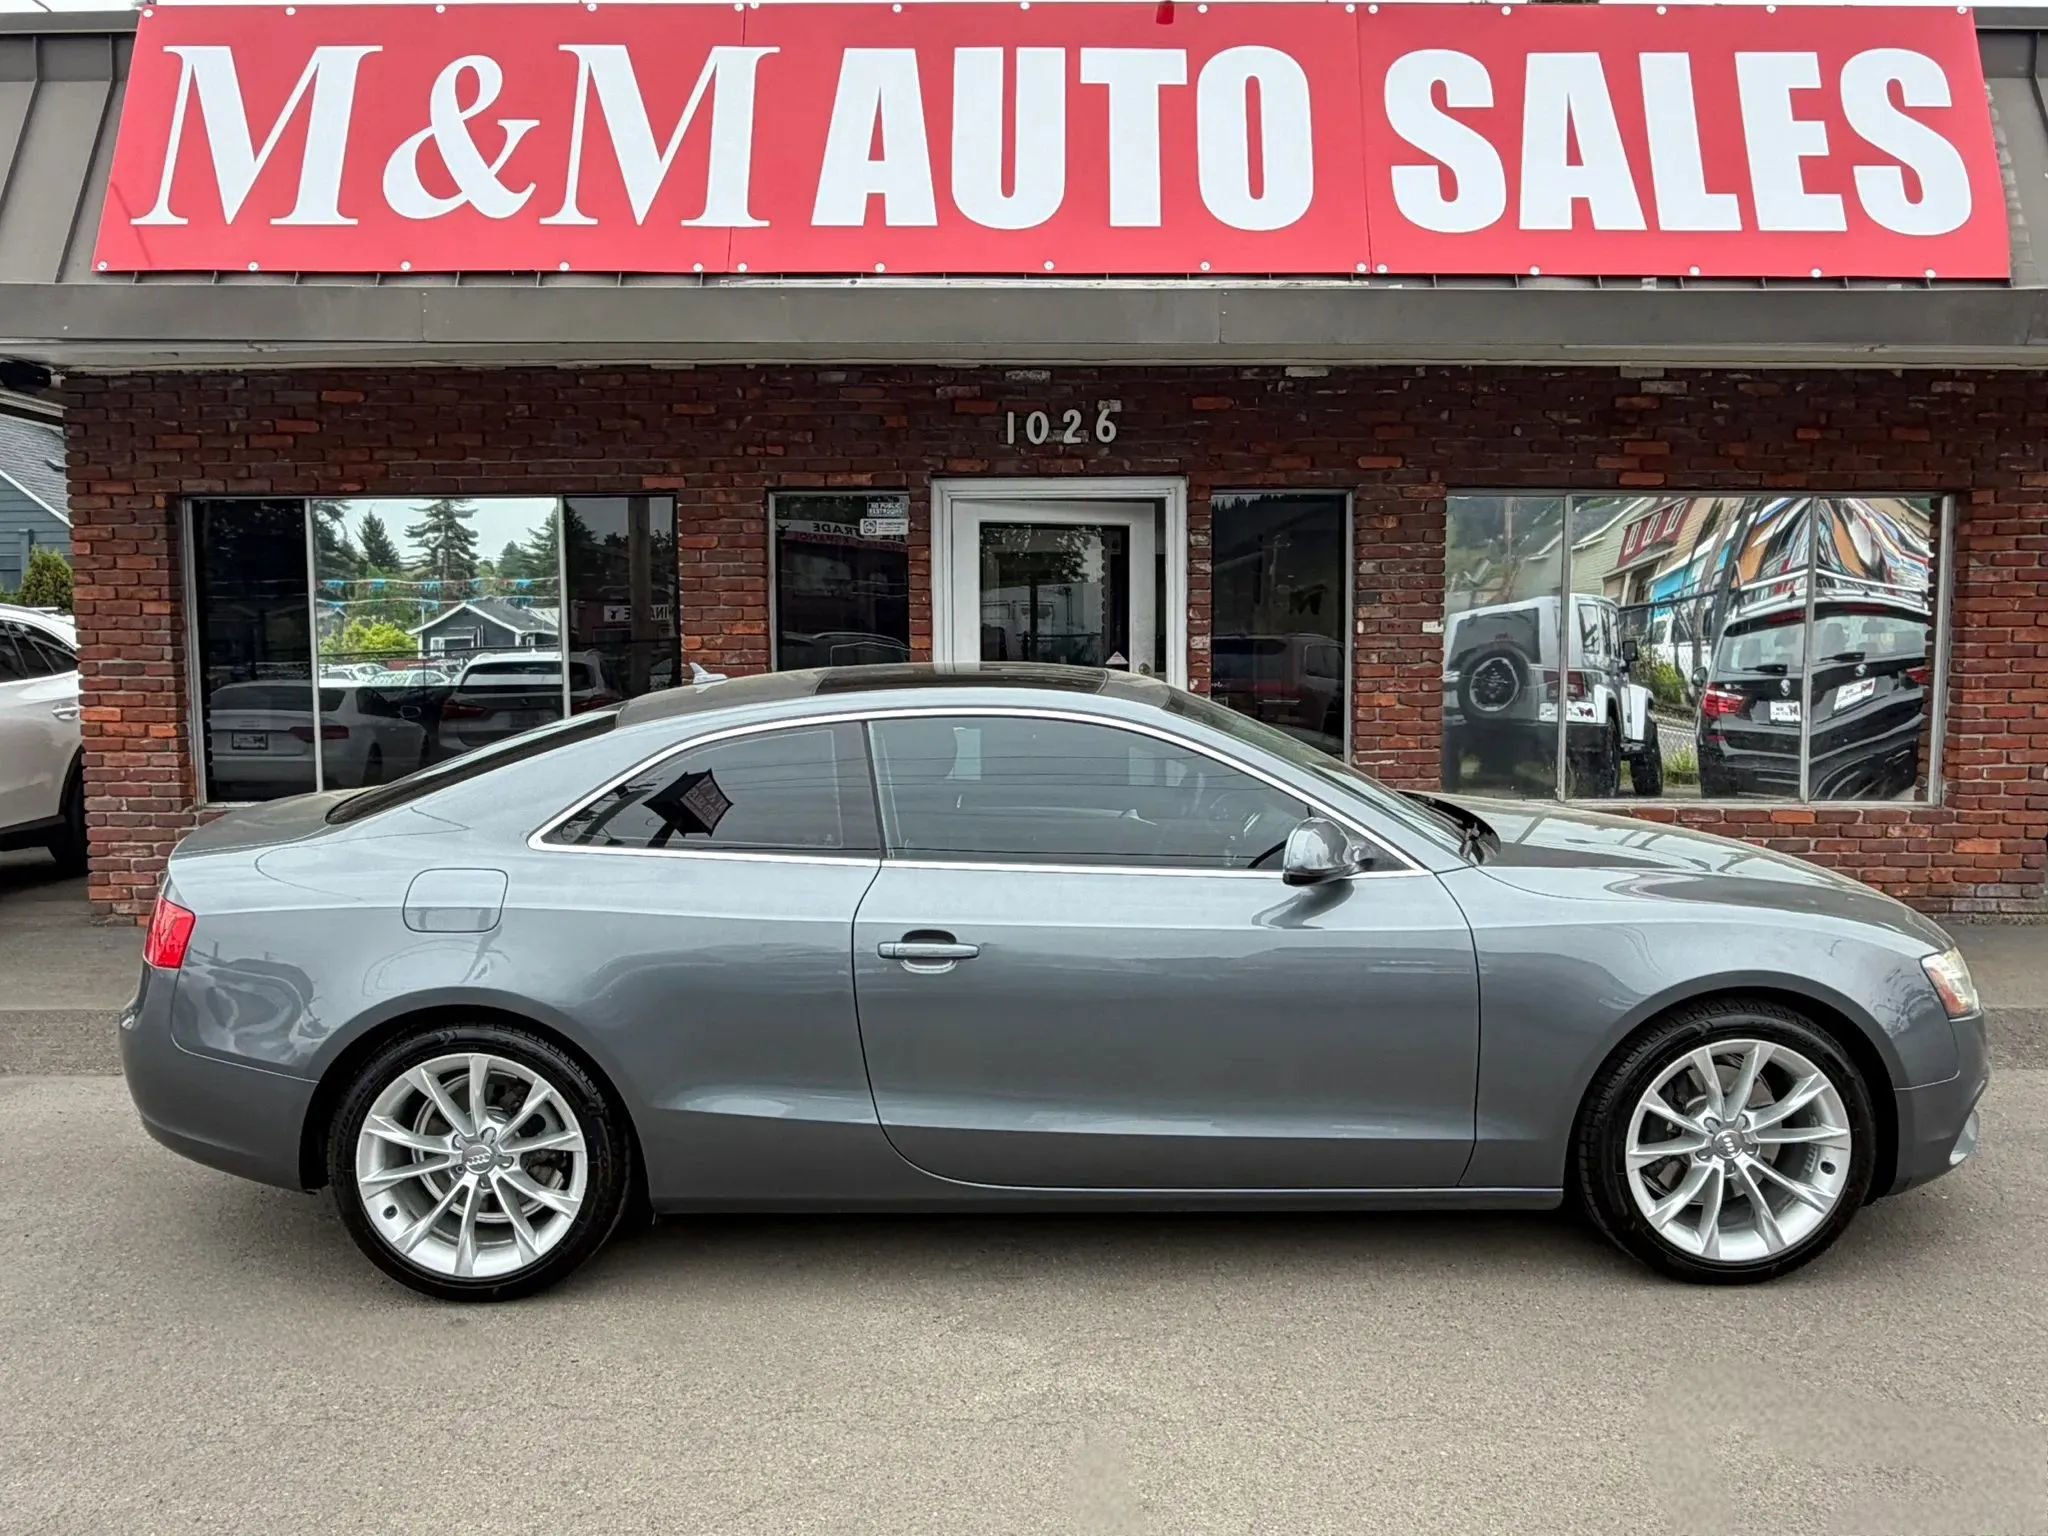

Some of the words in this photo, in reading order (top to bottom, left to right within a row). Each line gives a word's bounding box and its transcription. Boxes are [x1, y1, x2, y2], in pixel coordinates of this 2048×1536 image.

[811, 46, 1313, 231] AUTO
[1385, 48, 1971, 235] SALES
[1007, 408, 1117, 445] 1026
